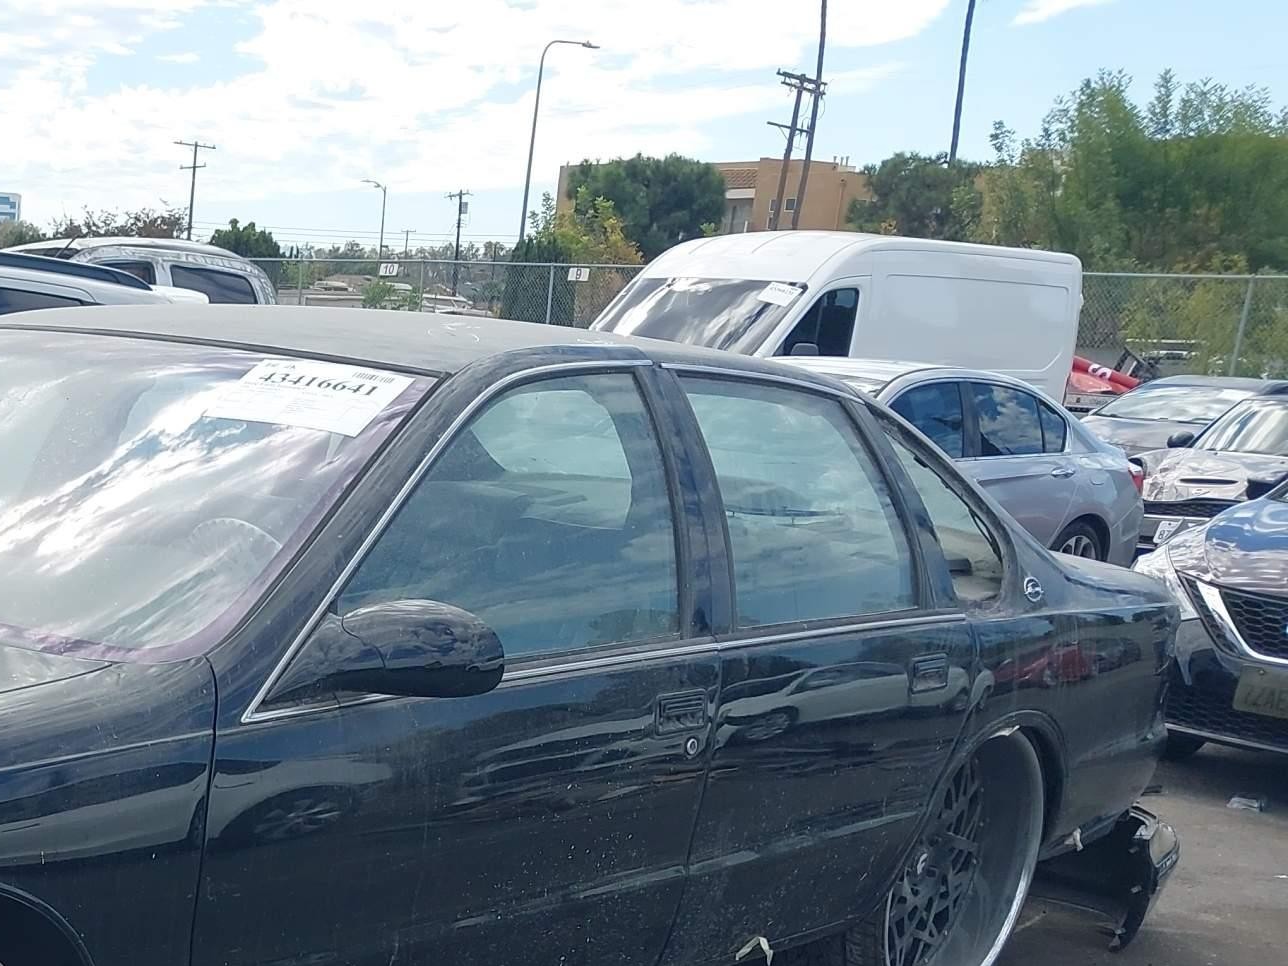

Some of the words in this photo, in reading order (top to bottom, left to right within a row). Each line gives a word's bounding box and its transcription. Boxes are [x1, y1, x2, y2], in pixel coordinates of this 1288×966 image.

[383, 264, 395, 275] 10
[575, 268, 583, 280] 9
[259, 372, 379, 396] 43416641
